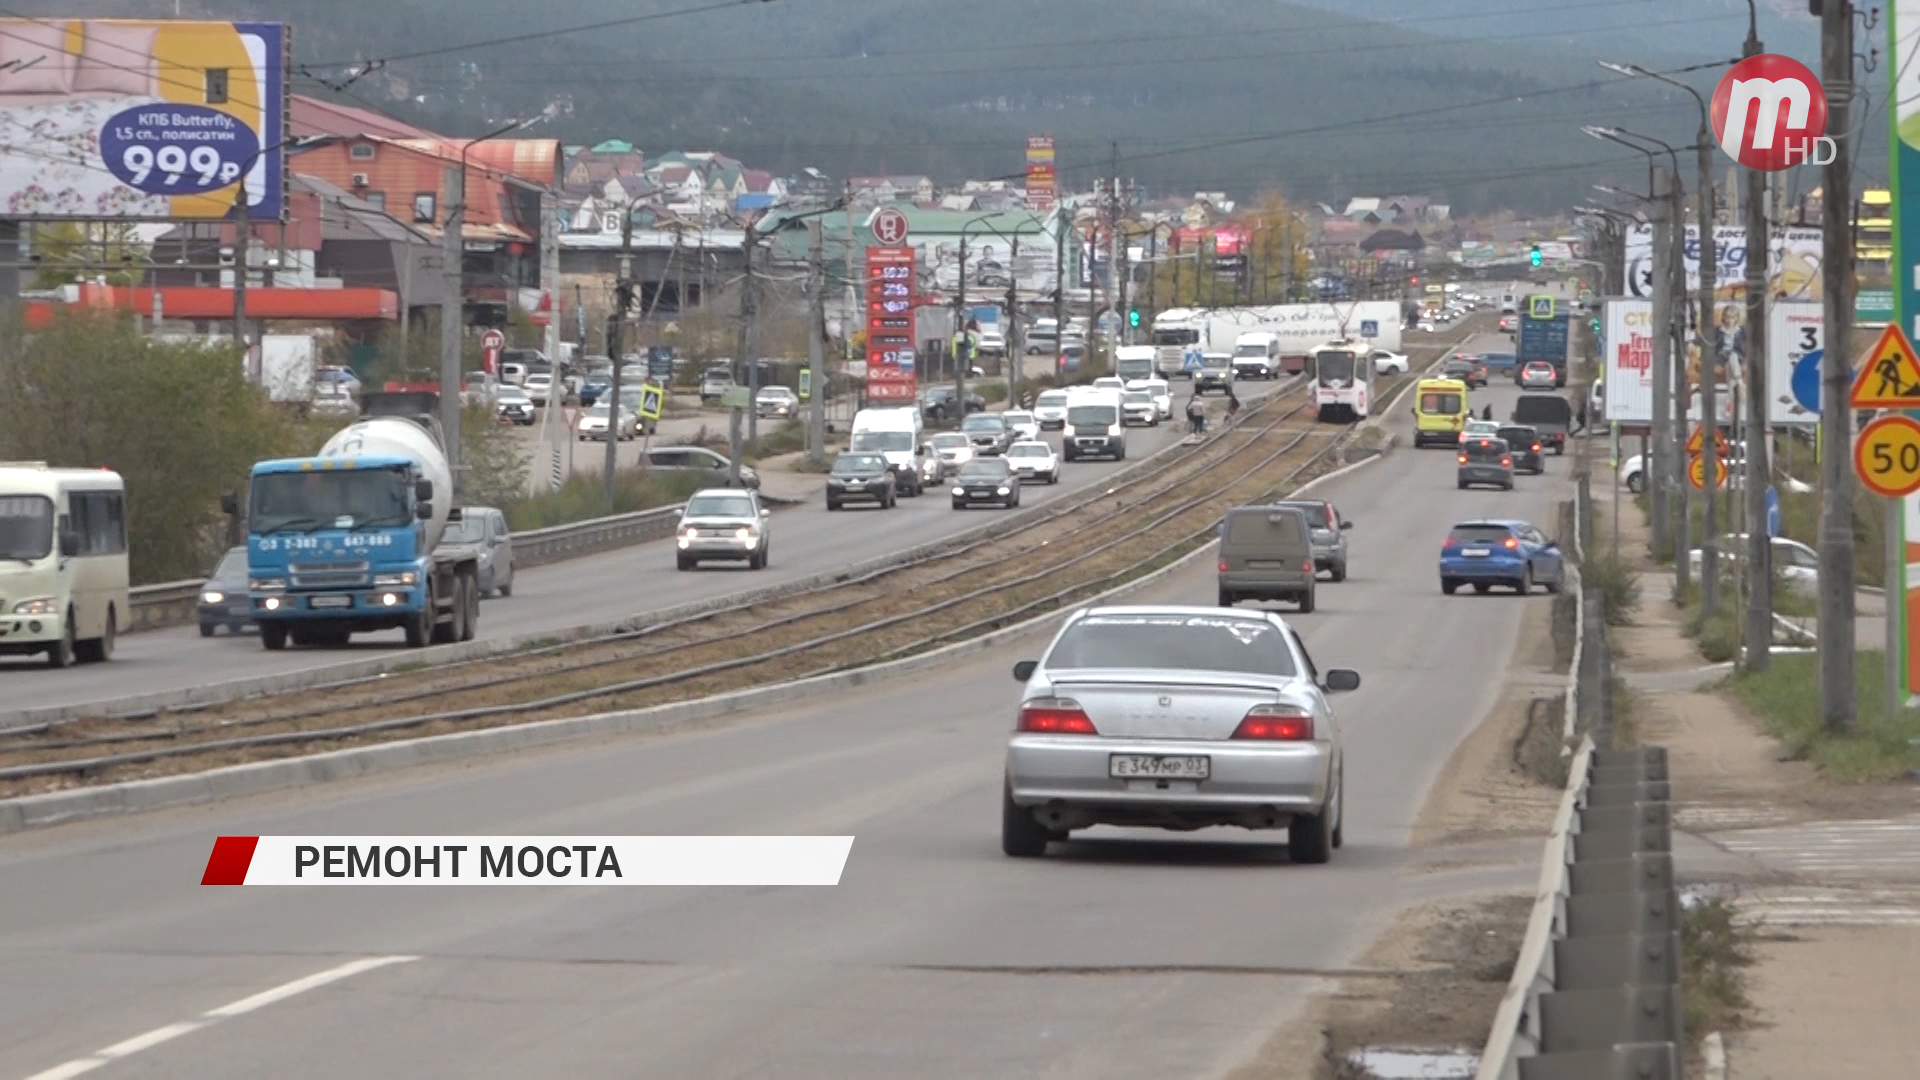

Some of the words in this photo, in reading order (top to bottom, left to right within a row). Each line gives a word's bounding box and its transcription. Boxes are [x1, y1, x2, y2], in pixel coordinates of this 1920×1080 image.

[138, 113, 168, 126] КПБ
[172, 112, 235, 129] Butterfly,
[115, 127, 134, 141] 1,5
[162, 129, 235, 141] полисатин
[1799, 326, 1817, 350] 3
[1873, 443, 1919, 474] 50
